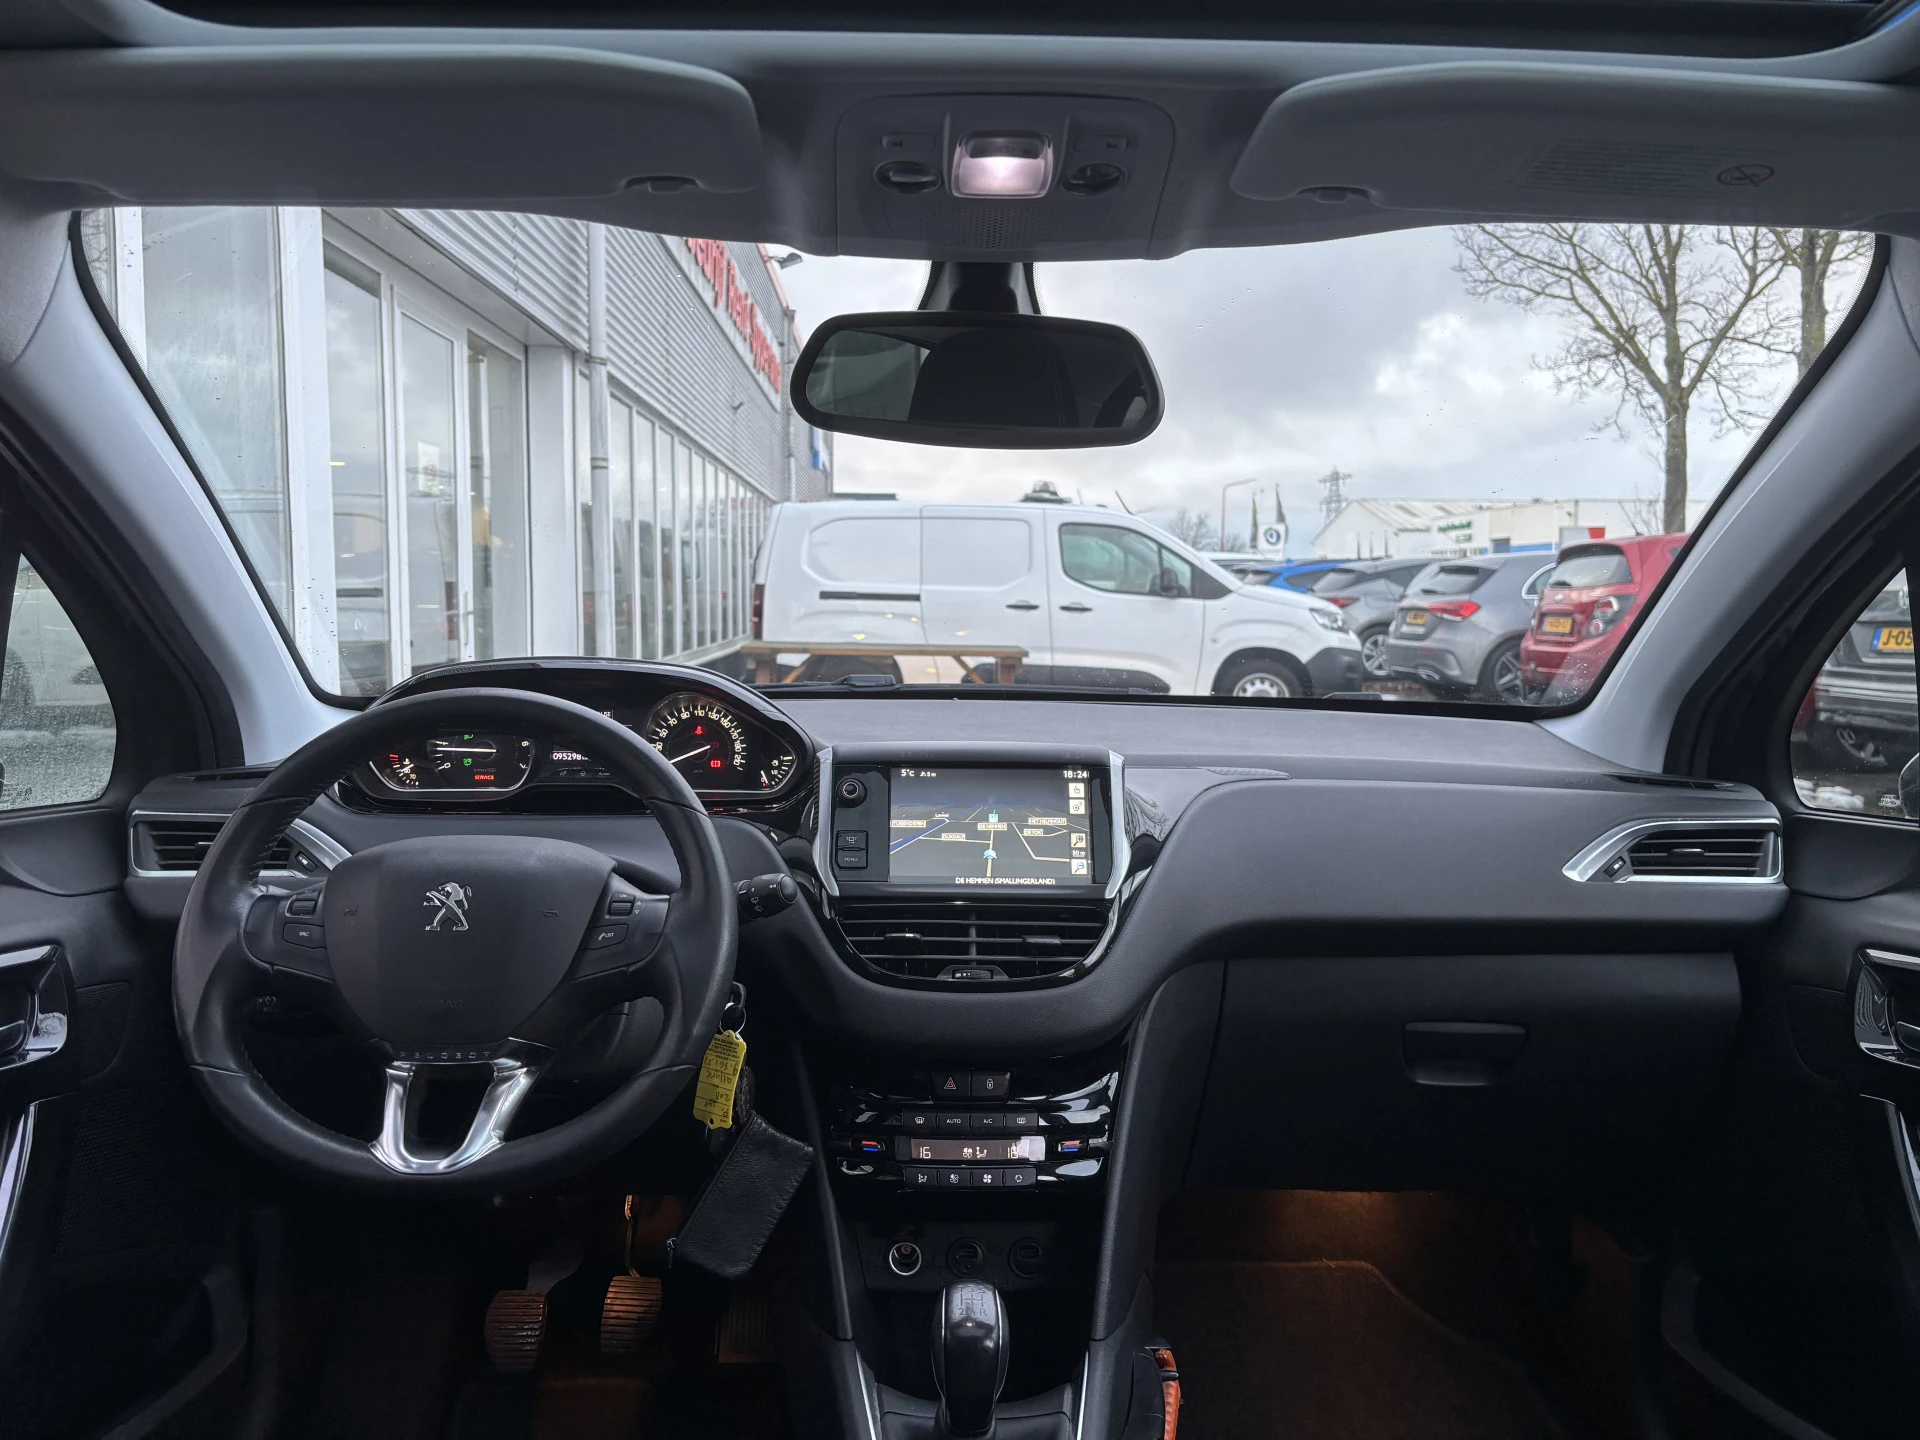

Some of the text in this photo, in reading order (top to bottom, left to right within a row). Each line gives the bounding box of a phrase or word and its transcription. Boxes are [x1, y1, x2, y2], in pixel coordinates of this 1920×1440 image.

[680, 711, 690, 720] 90
[694, 709, 705, 717] 110
[707, 711, 720, 721] 130
[667, 718, 678, 727] 70
[719, 716, 732, 729] 150
[659, 728, 669, 738] 50
[729, 727, 739, 740] 170
[655, 741, 663, 751] 30
[552, 752, 581, 761] 095298
[1063, 770, 1087, 779] 18:24
[994, 877, 1056, 885] (SMALLINGERLAND)
[919, 1146, 931, 1159] 16
